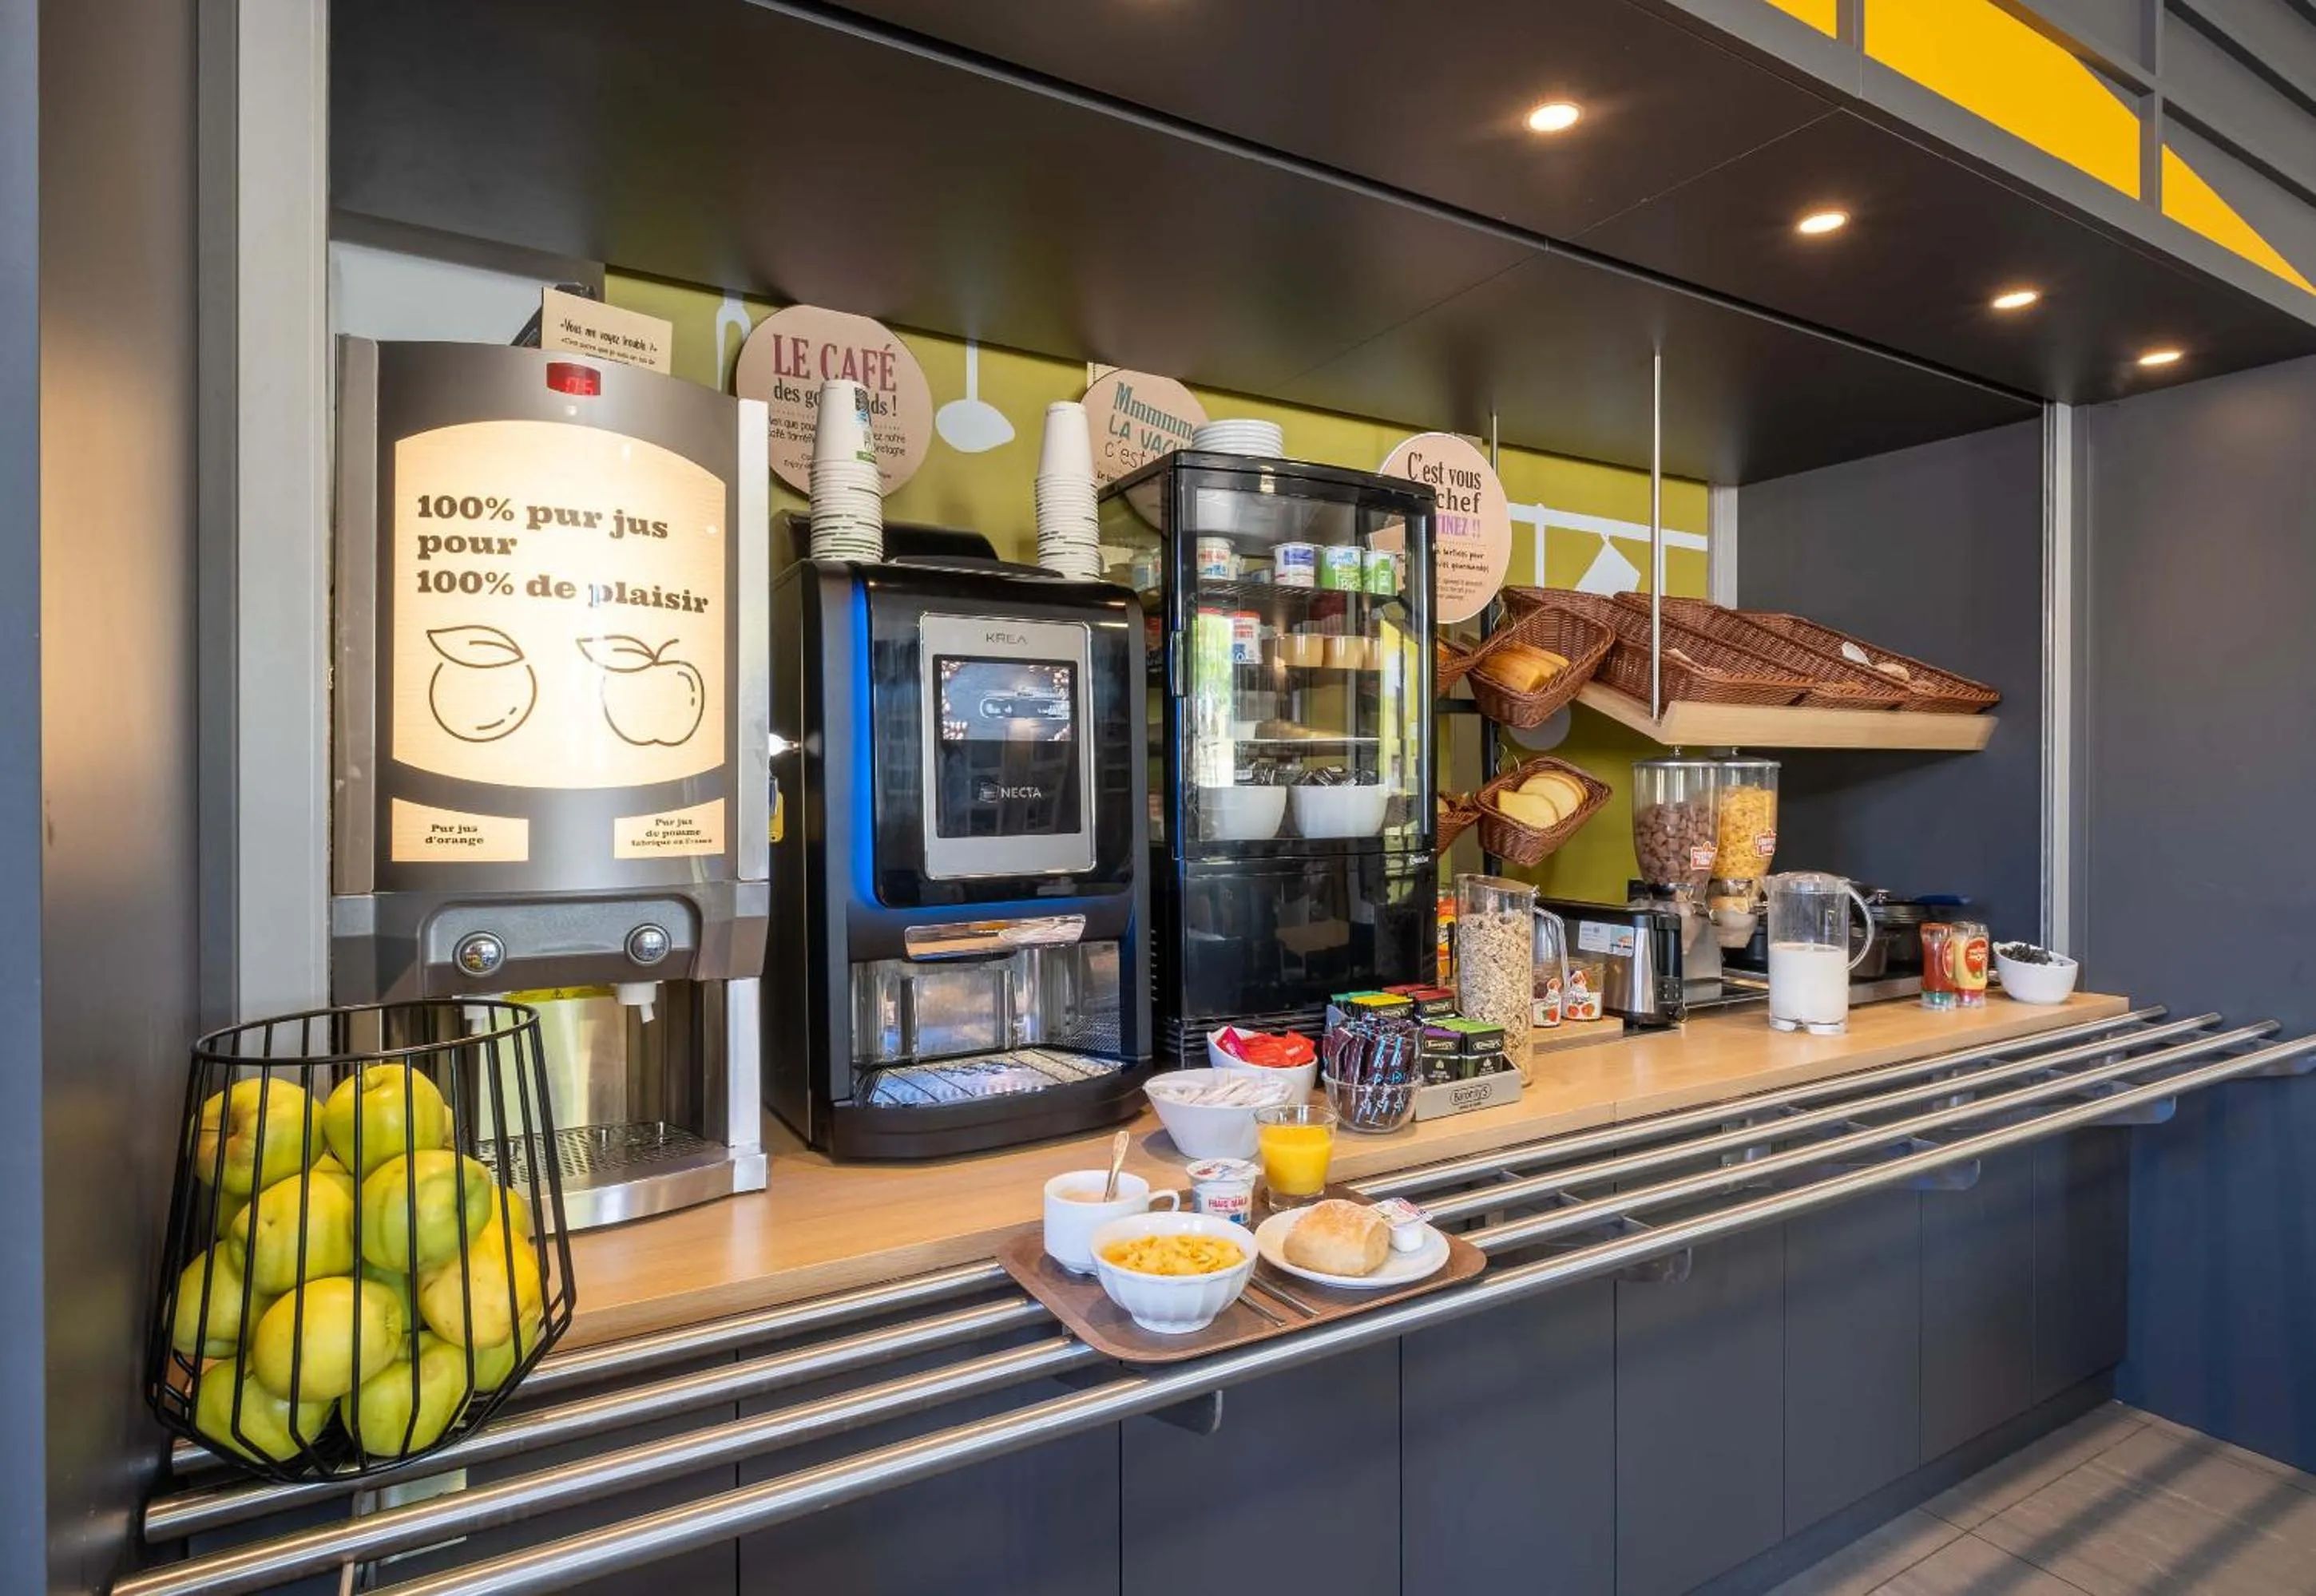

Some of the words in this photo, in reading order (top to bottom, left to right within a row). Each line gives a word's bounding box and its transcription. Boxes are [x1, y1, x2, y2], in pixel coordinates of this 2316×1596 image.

[773, 334, 811, 379] LE
[819, 343, 896, 392] CAFÉ
[775, 378, 799, 402] des
[1109, 414, 1131, 441] LA
[1140, 428, 1185, 454] VAC
[1104, 441, 1146, 468] C'est
[1407, 452, 1443, 484] C'est
[1449, 469, 1481, 490] vous
[1437, 488, 1481, 513] chef
[417, 494, 514, 521] 100%
[526, 503, 602, 530] pur
[609, 509, 668, 539] jus
[417, 534, 518, 560] pour
[417, 570, 514, 595] 100%
[525, 575, 577, 599] de
[588, 581, 709, 613] plaisir
[986, 633, 1028, 644] KREA
[1001, 786, 1041, 799] NECTA
[425, 835, 484, 846] d'orange
[431, 824, 454, 834] Pur
[458, 824, 478, 834] jus
